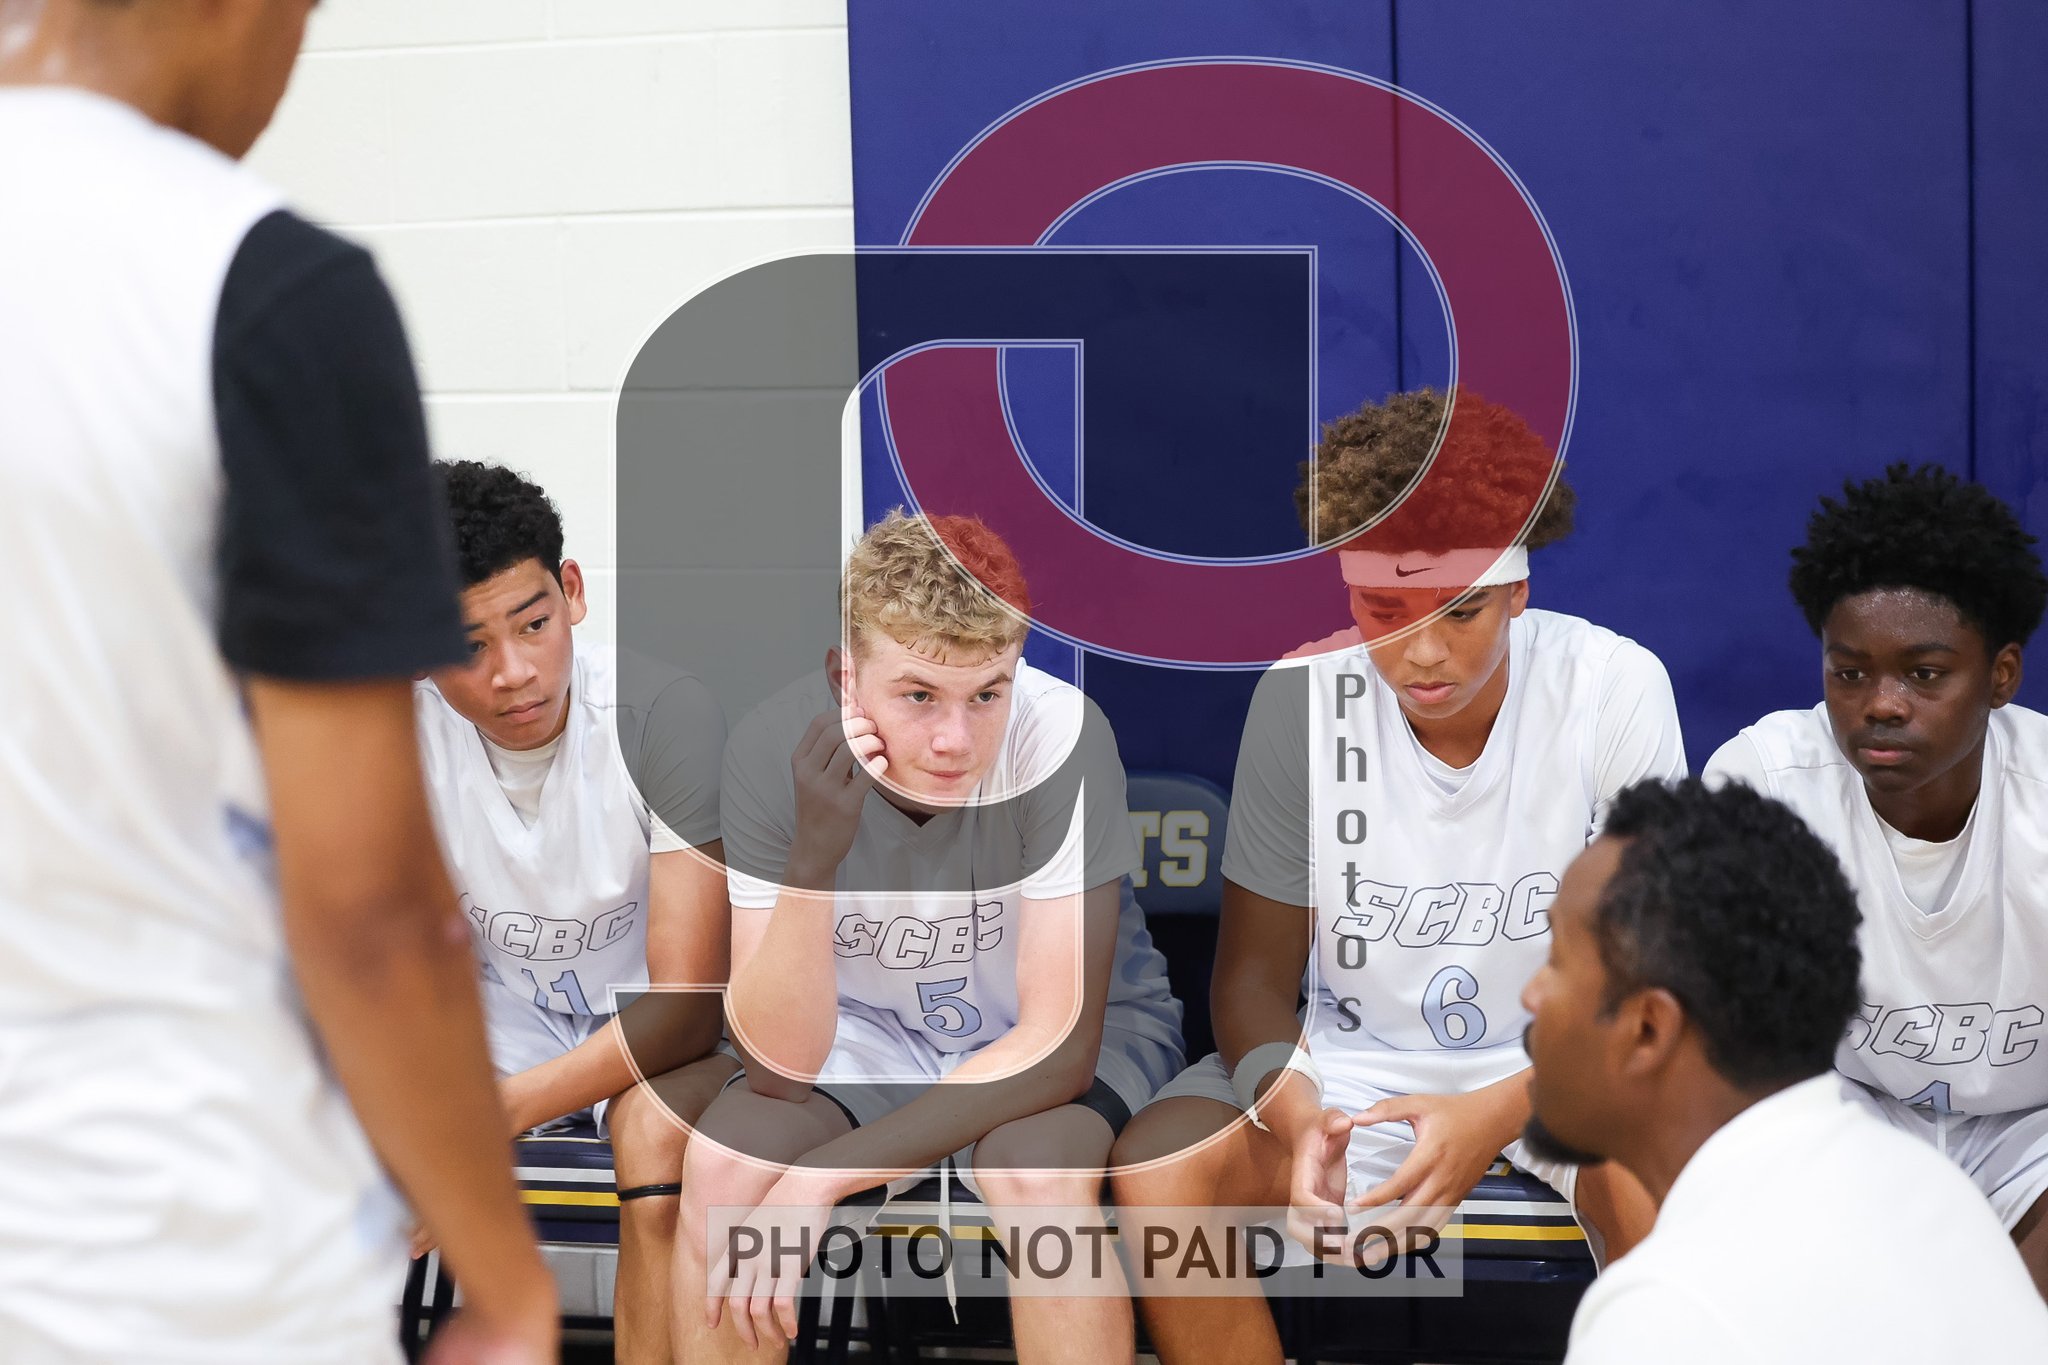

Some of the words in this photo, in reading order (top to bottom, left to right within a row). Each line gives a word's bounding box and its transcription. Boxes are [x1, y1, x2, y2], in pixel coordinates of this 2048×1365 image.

[833, 901, 1003, 970] SCBC
[1331, 872, 1559, 948] SCBC
[915, 976, 983, 1038] 5
[1421, 965, 1487, 1048] 6
